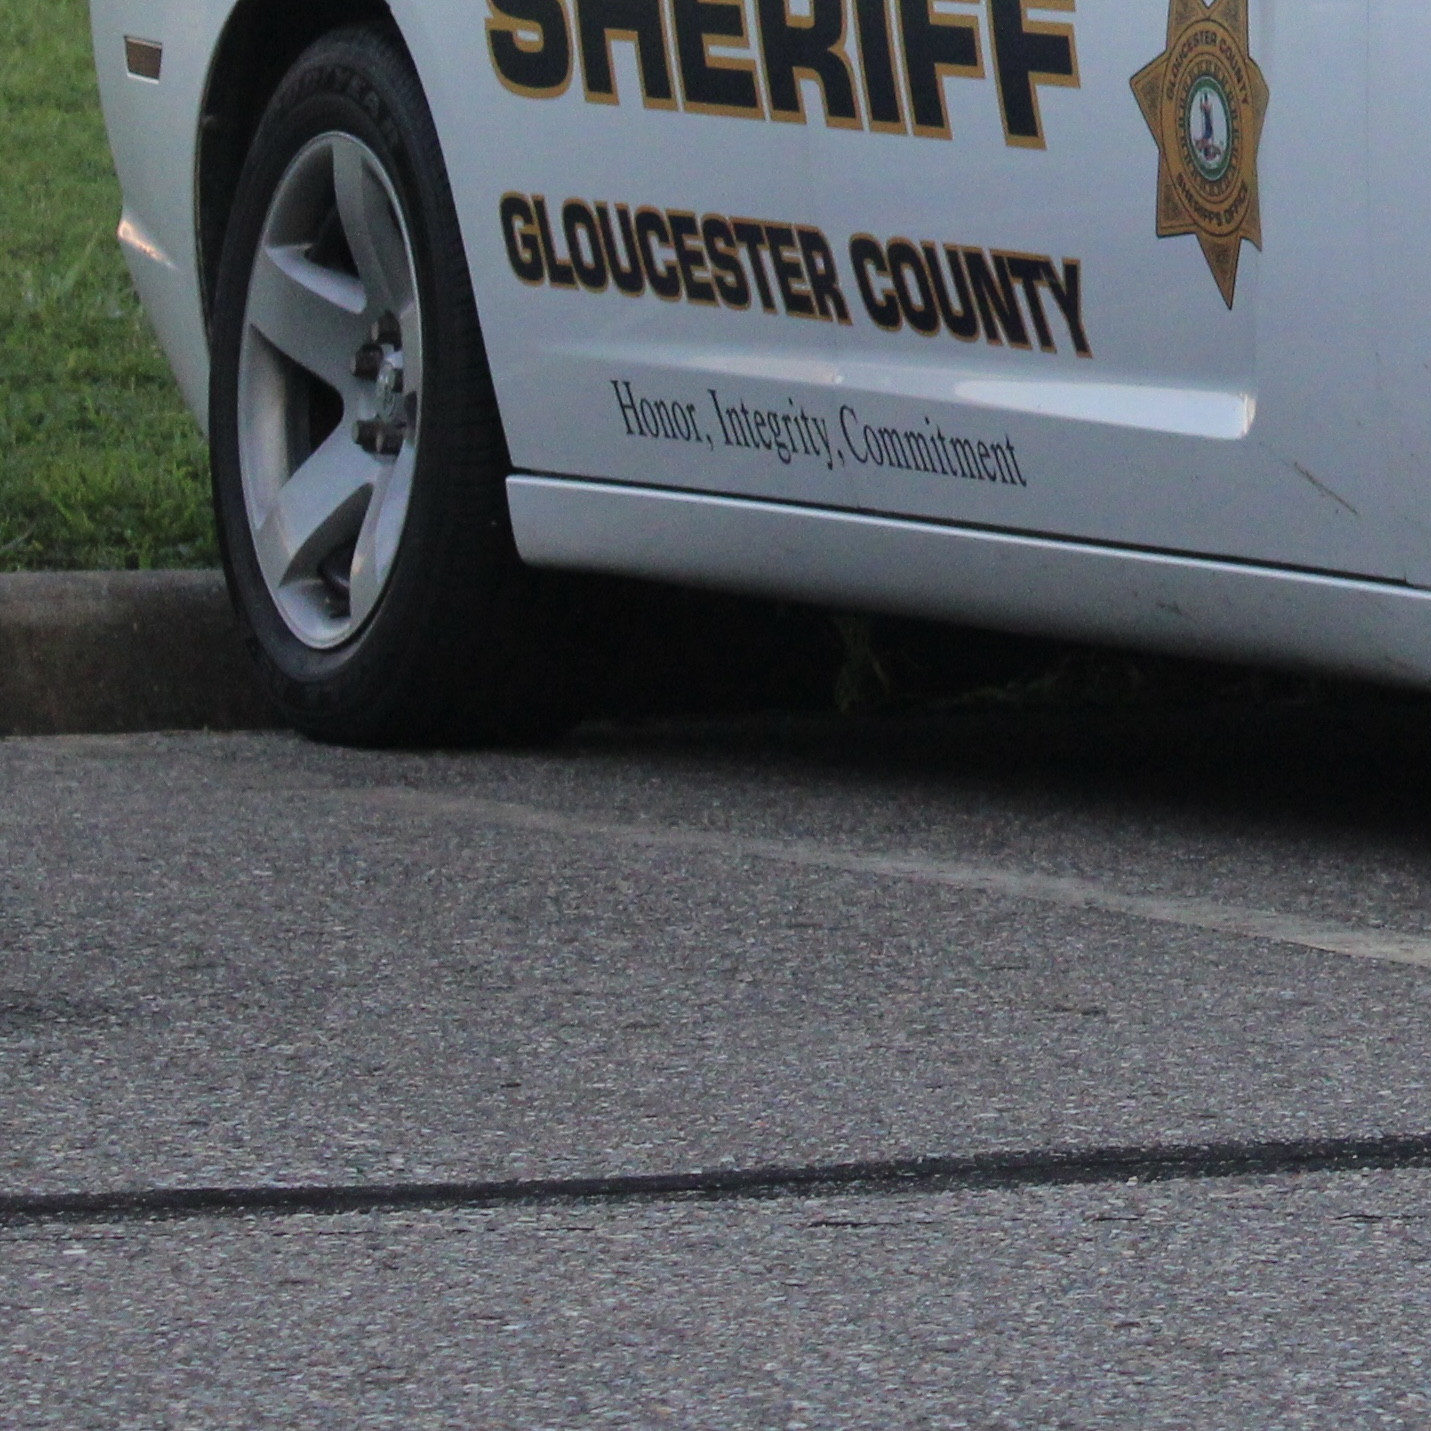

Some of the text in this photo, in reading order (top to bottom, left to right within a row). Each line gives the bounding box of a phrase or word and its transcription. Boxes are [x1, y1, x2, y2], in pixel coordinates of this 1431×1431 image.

[1166, 31, 1249, 104] GLOUCESTER COUNTY
[499, 190, 1092, 358] GLOUCESTER COUNTY
[611, 380, 1027, 487] Honor, Integrity, Commitment
